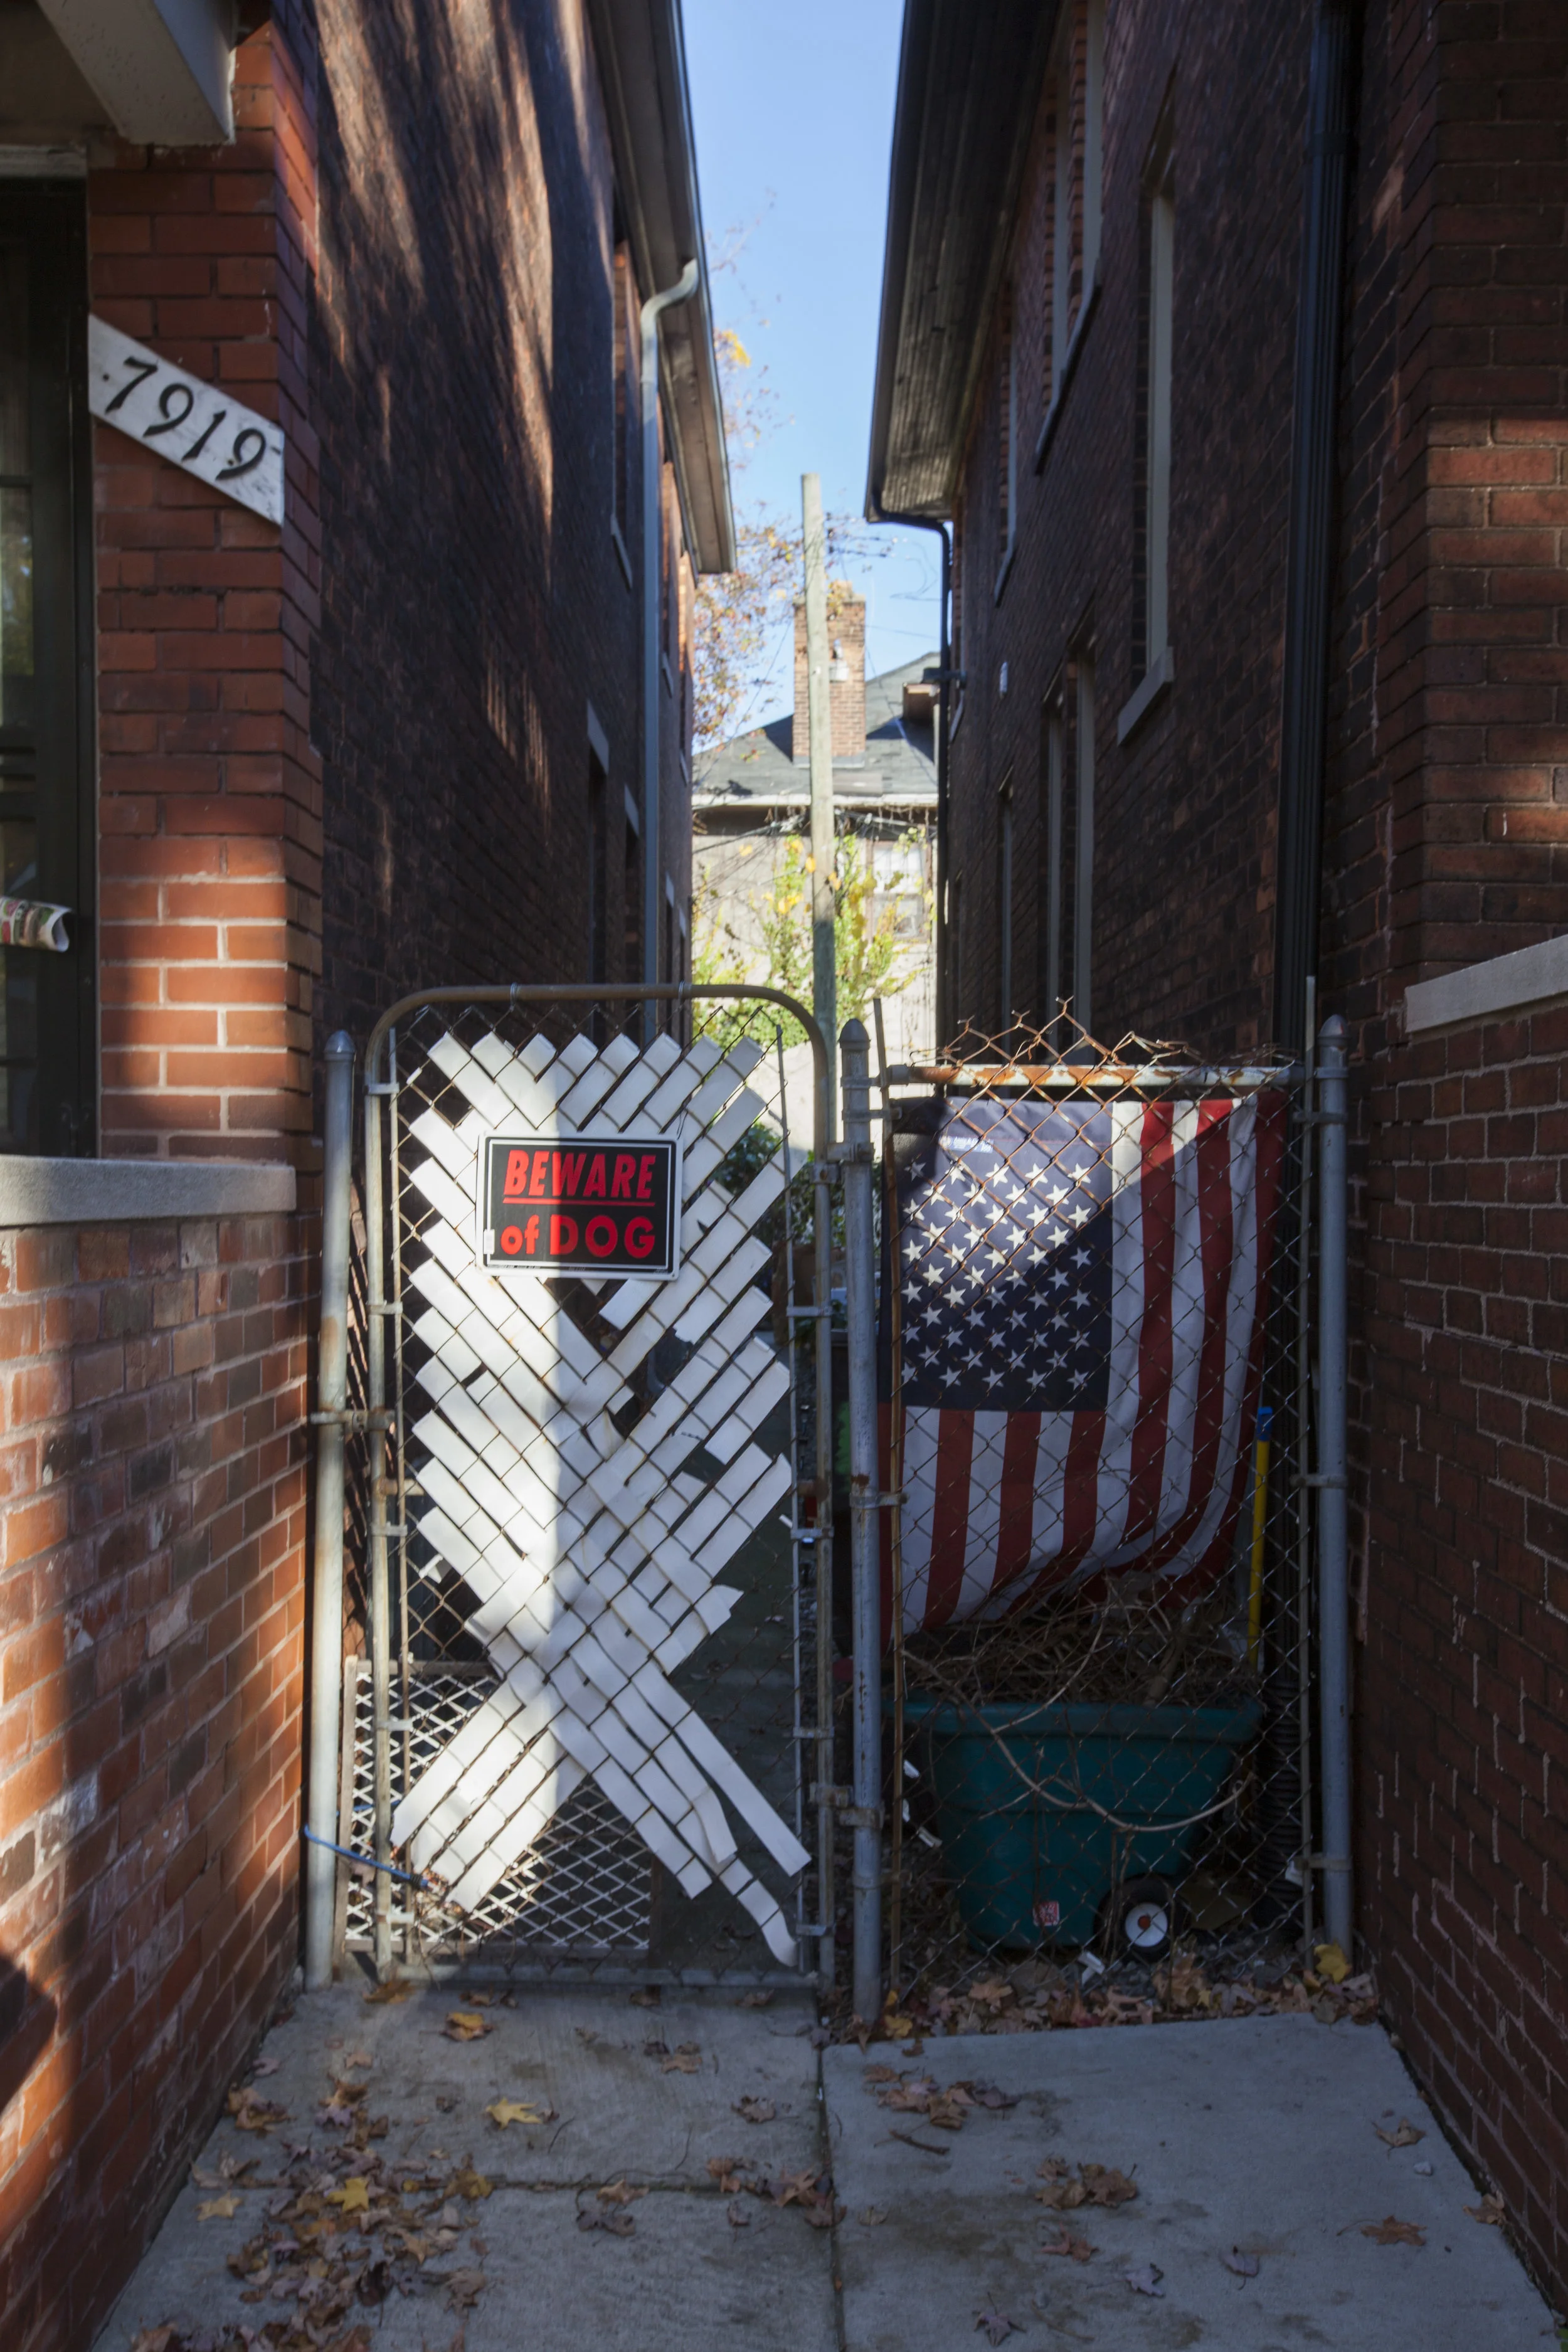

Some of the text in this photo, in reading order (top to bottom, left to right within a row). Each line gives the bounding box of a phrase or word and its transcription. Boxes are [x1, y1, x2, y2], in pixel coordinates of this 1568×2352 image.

[104, 355, 267, 481] 7919
[503, 1149, 657, 1199] BEWARE
[500, 1214, 655, 1259] of DOG
